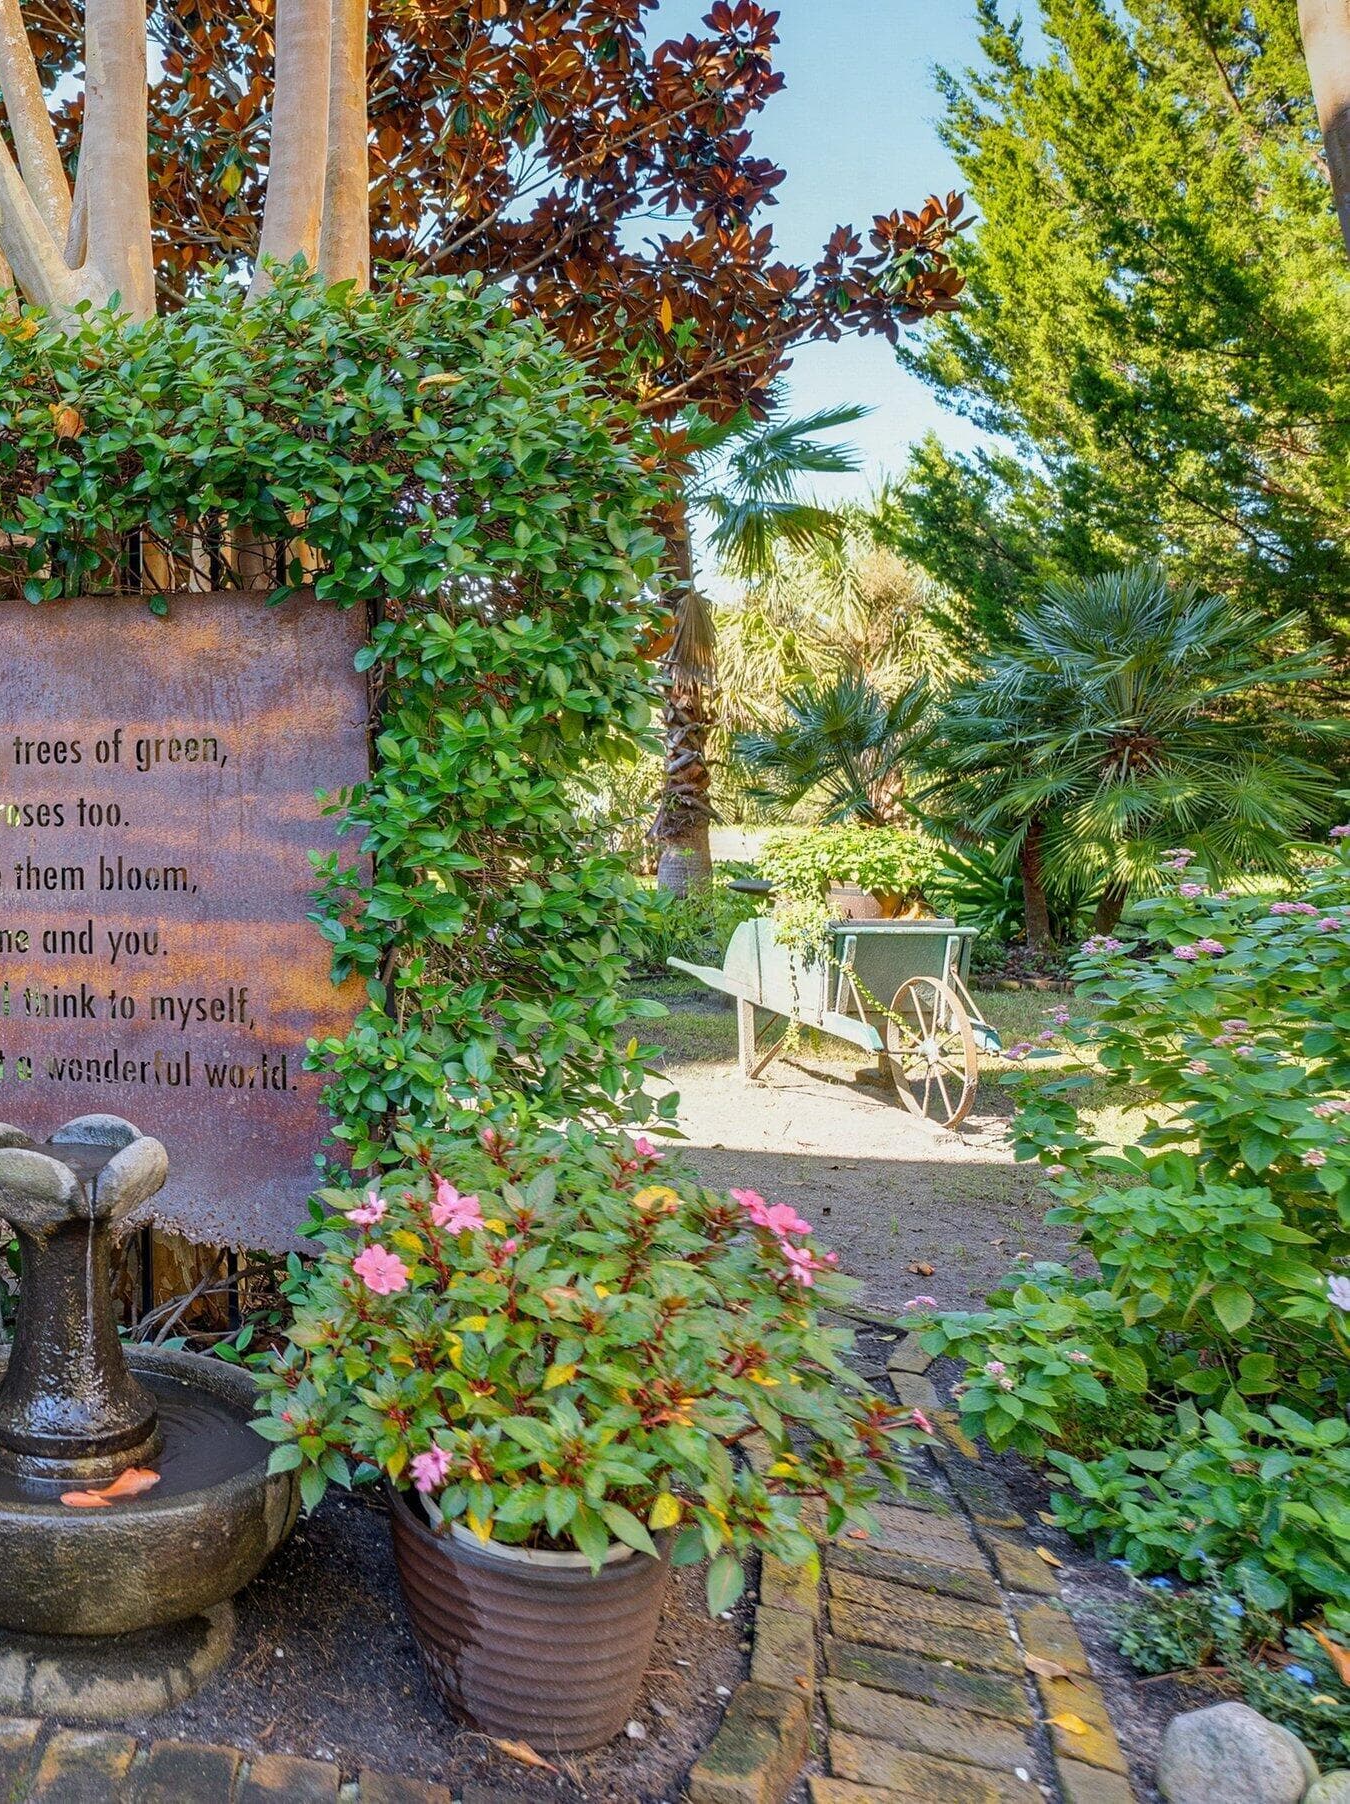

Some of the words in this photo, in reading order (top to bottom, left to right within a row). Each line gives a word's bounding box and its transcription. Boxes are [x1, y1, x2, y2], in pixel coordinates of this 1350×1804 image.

[12, 735, 83, 766] trees
[95, 729, 123, 764] of
[135, 732, 229, 772] green,
[77, 797, 131, 828] too.
[13, 855, 86, 892] them
[99, 855, 199, 895] bloom,
[42, 919, 94, 956] and
[107, 929, 168, 964] you.
[24, 983, 95, 1020] think
[108, 989, 136, 1020] to
[150, 986, 256, 1031] myself,
[17, 1057, 33, 1081] a
[48, 1048, 191, 1089] wonderful
[203, 1054, 299, 1092] world.
